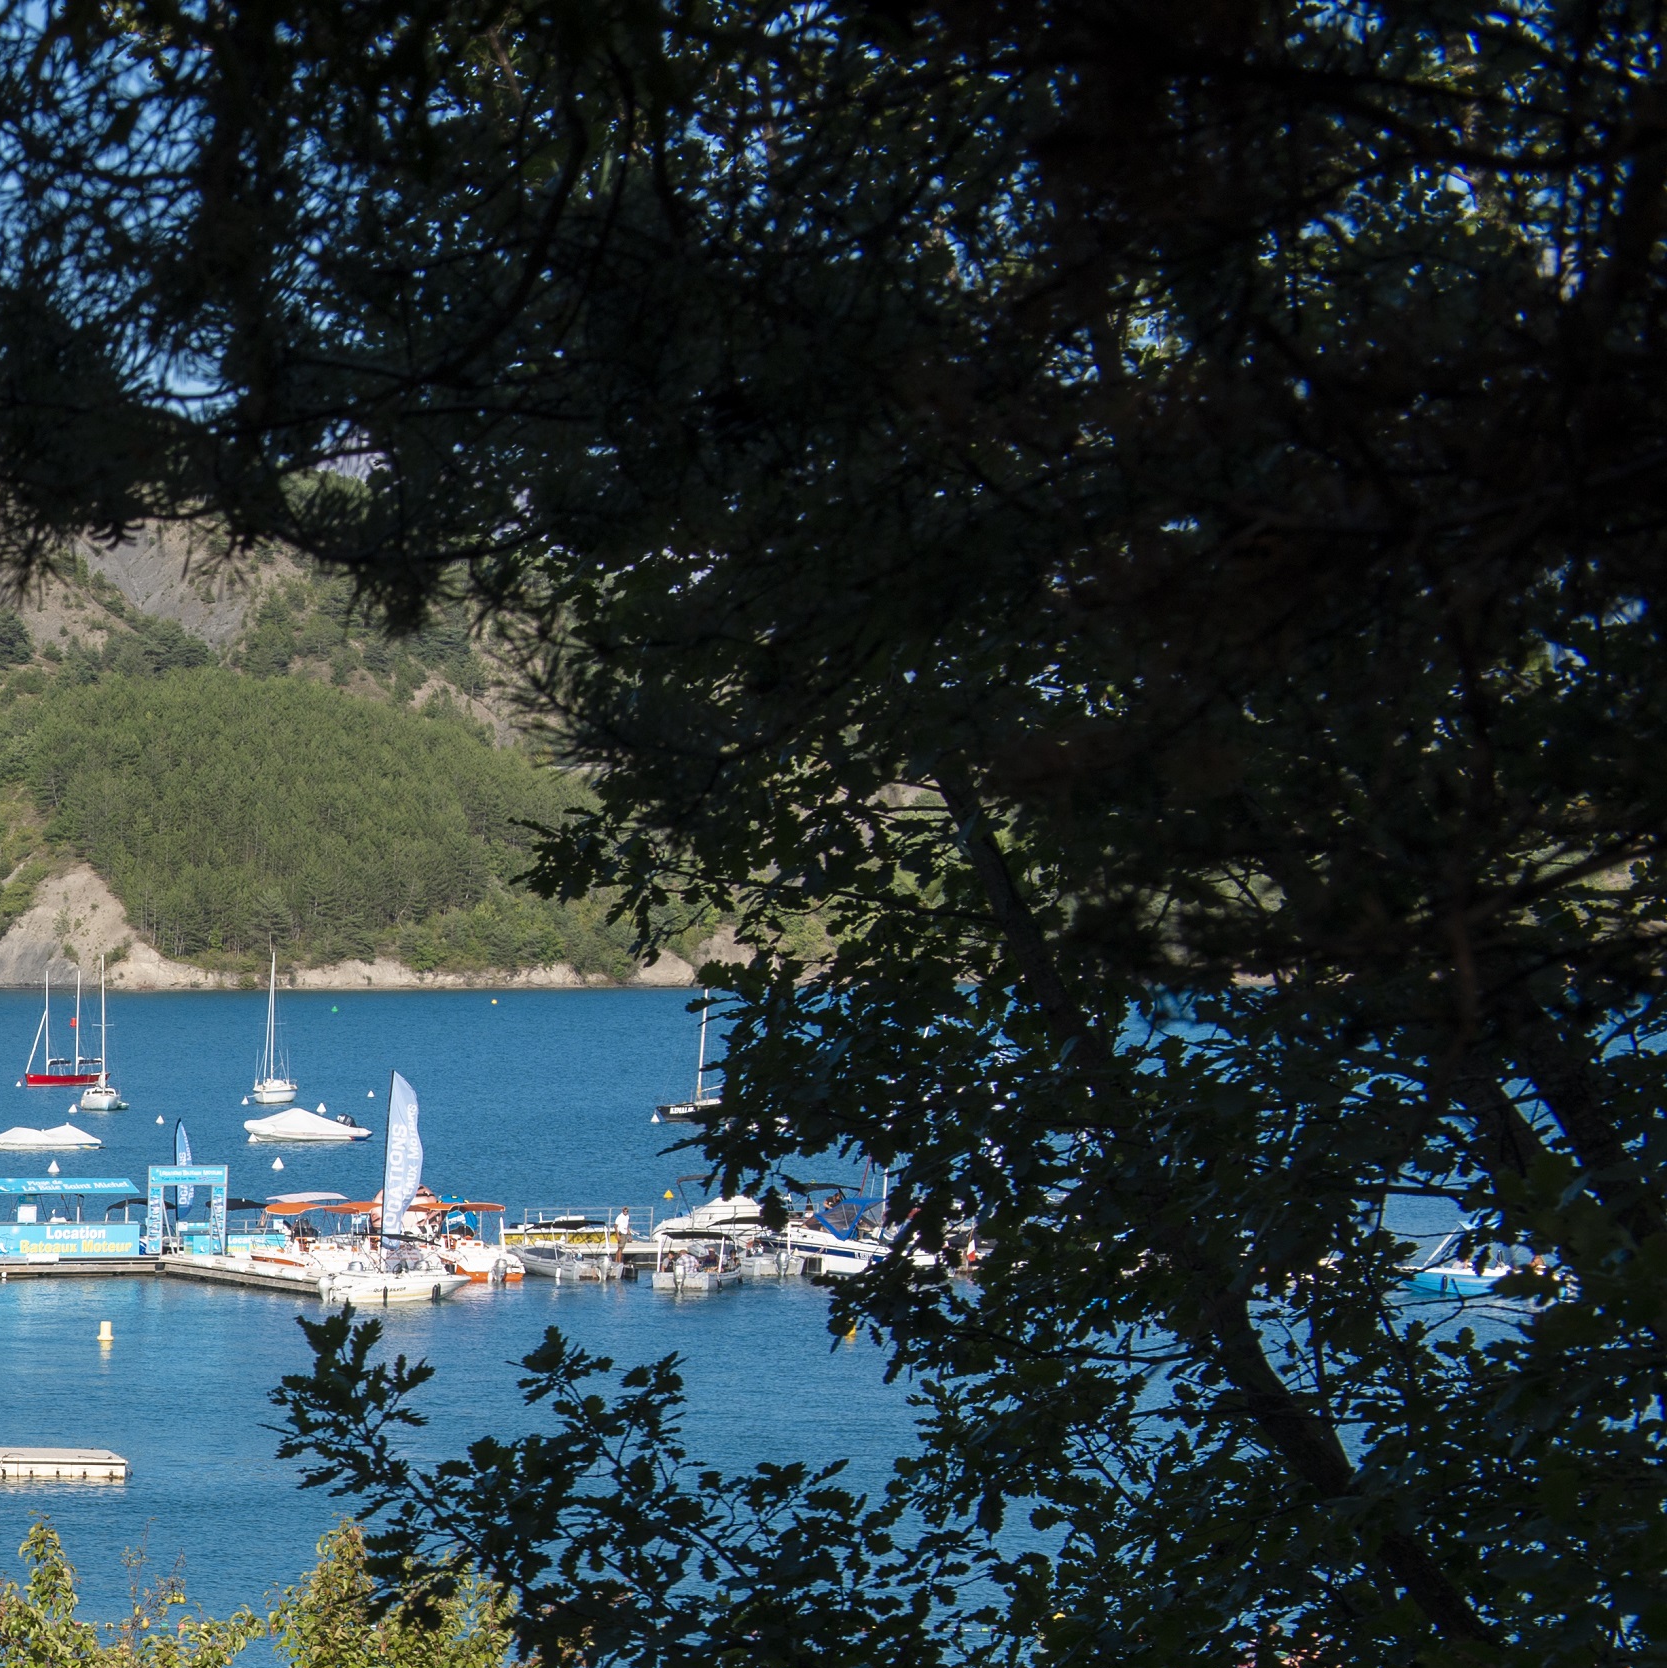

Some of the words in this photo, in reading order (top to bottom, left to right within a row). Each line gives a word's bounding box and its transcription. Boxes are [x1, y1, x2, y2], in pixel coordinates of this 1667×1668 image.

[407, 1103, 419, 1160] MOTEURS
[94, 1180, 130, 1189] Michel
[384, 1122, 408, 1235] LOCATIONS
[46, 1226, 106, 1239] Location
[19, 1239, 78, 1253] Bateaux
[81, 1239, 132, 1253] Moteur
